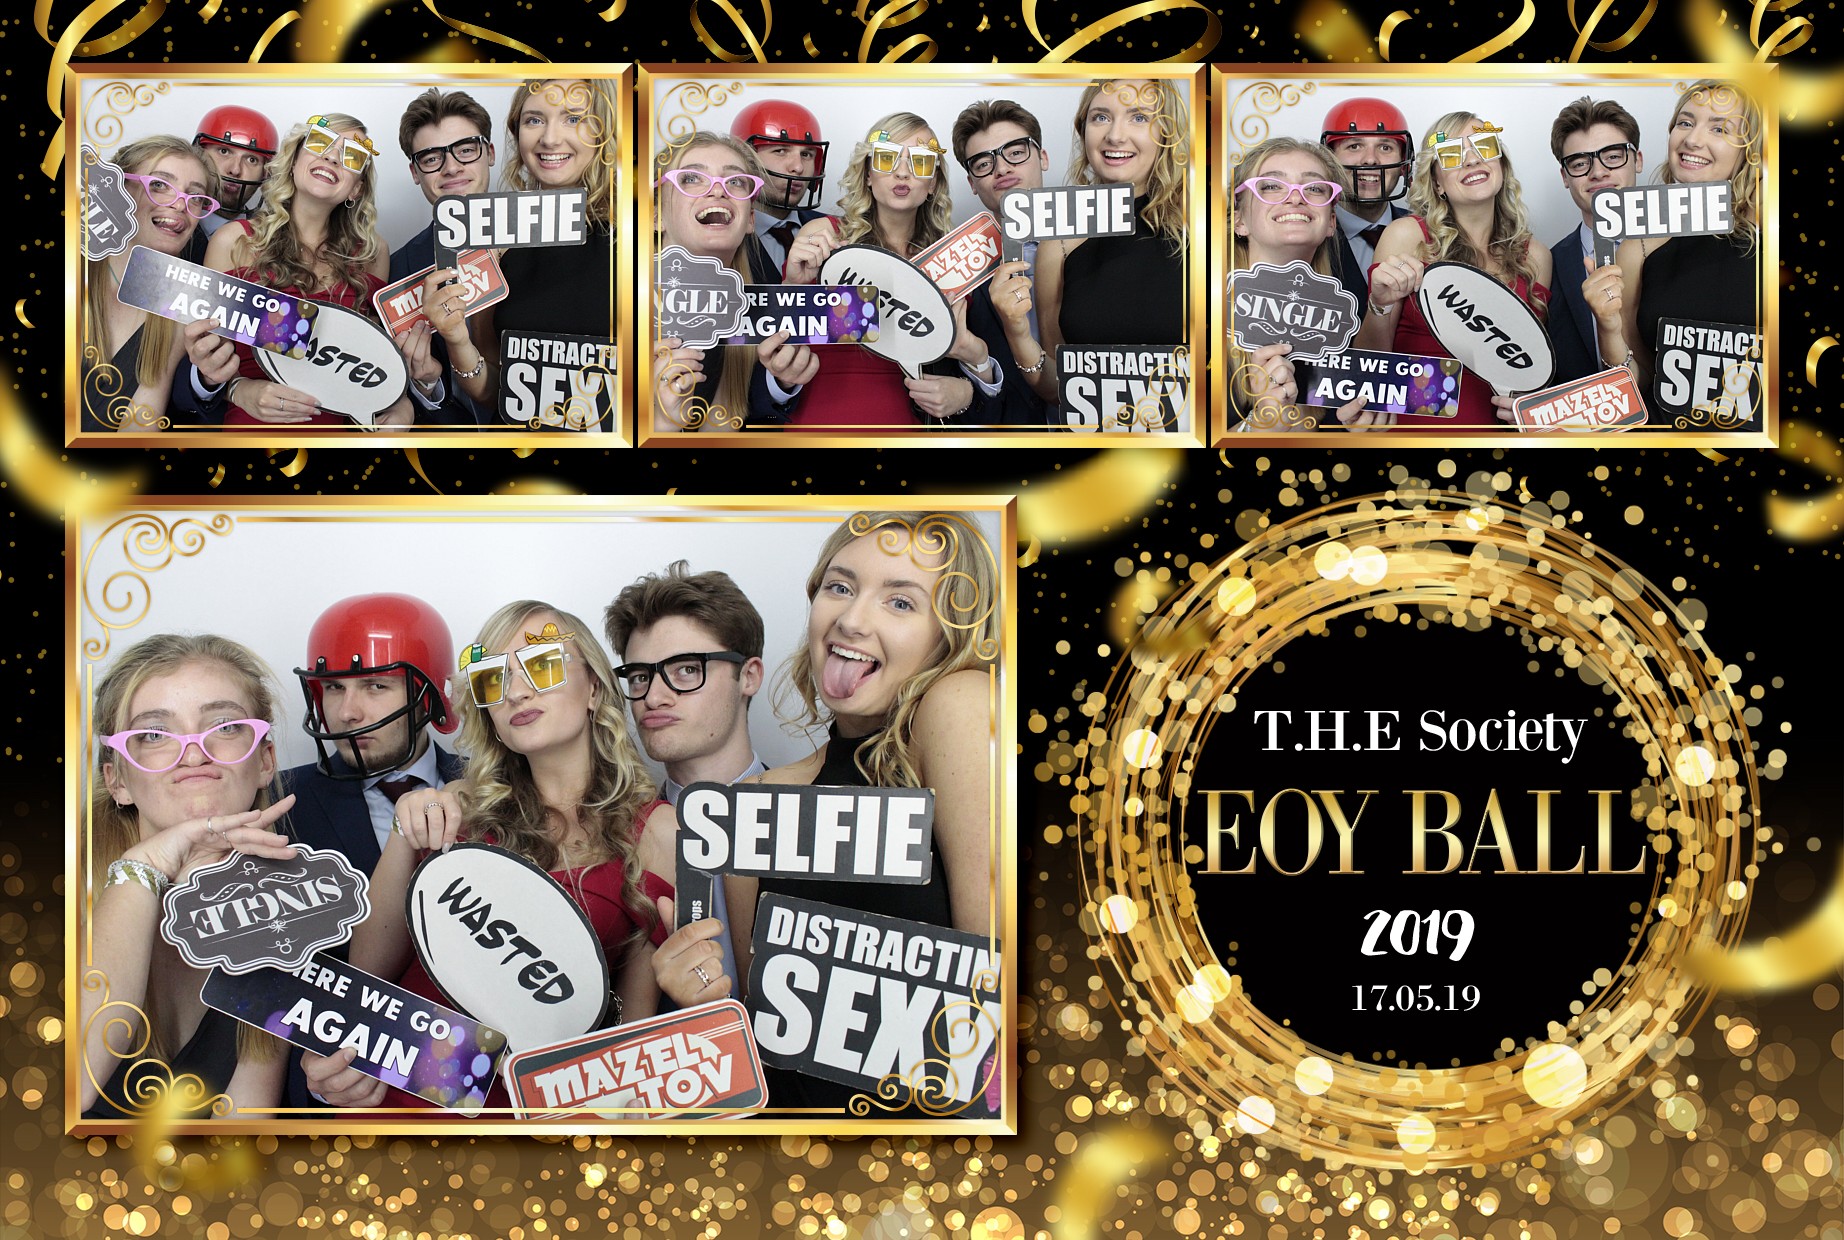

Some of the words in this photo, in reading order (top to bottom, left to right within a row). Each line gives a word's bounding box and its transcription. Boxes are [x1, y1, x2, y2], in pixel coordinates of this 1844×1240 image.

[436, 193, 582, 248] SELFIE
[1004, 187, 1132, 240] SELFIE
[1594, 185, 1729, 238] SELFIE
[921, 234, 982, 281] AZEL
[954, 236, 999, 279] TOV
[165, 264, 212, 291] HERE
[218, 281, 248, 303] WE
[252, 294, 280, 313] GO
[169, 292, 260, 338] AGAIN
[776, 292, 806, 307] WE
[813, 292, 842, 307] GO
[1234, 292, 1343, 334] SINGLE
[738, 315, 828, 337] AGAIN
[1437, 284, 1533, 370] WASTED
[305, 337, 388, 388] ASTED
[1359, 357, 1389, 374] WE
[1395, 362, 1424, 377] GO
[1660, 349, 1763, 422] SEX
[1315, 377, 1408, 406] AGAIN
[1529, 383, 1613, 426] MAZEL
[1583, 394, 1630, 427] TOV
[682, 789, 927, 878] SELFIE
[189, 873, 343, 939] SINGLE
[437, 877, 575, 1004] WASTED
[280, 997, 420, 1077] AGAIN
[360, 985, 404, 1021] WE
[410, 1010, 451, 1041] GO
[754, 953, 1002, 1103] SEXY
[534, 1032, 701, 1108] MAZEL
[638, 1054, 733, 1110] TOV
